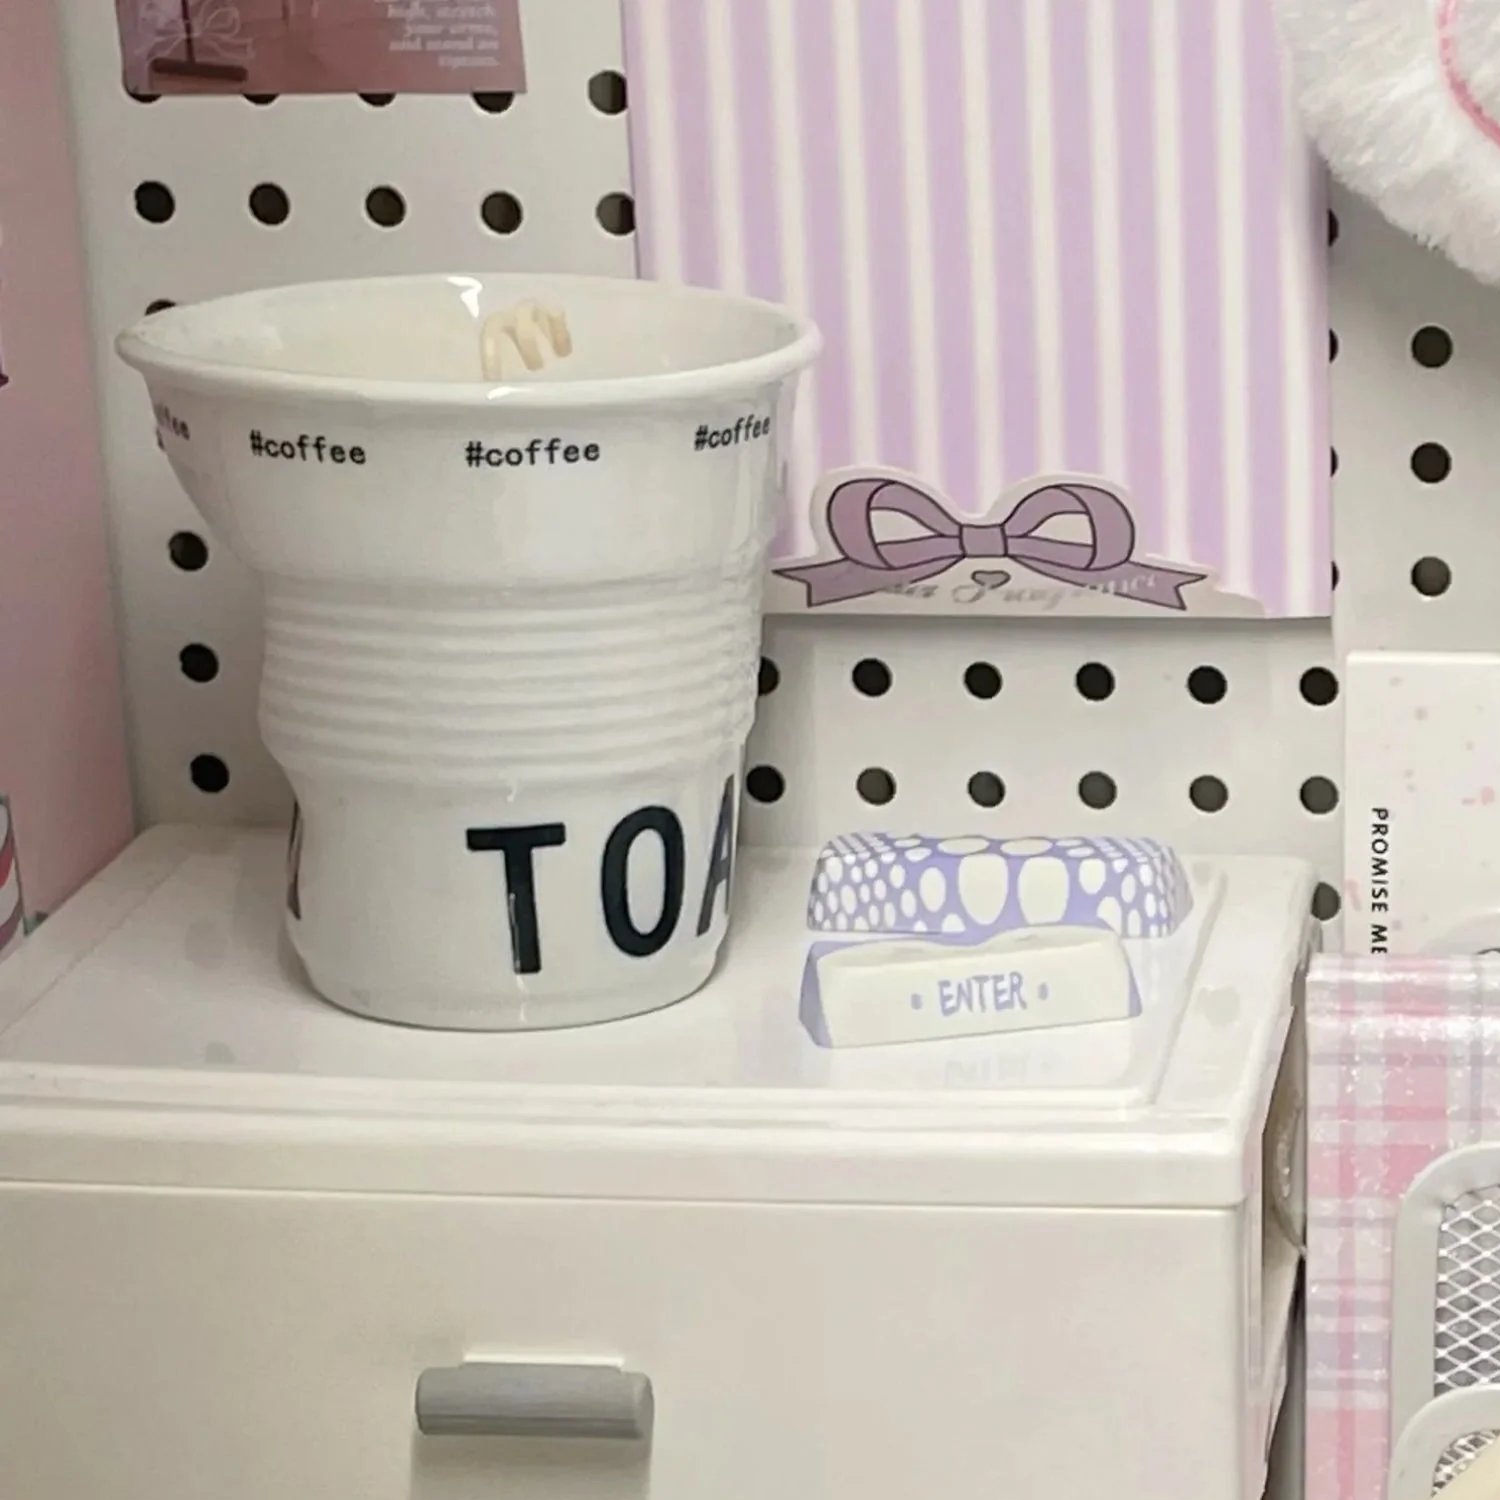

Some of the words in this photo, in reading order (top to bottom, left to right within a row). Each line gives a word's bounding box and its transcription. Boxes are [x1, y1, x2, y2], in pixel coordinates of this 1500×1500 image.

[249, 428, 367, 466] #coffee
[694, 413, 771, 451] #coffee
[464, 437, 601, 468] #coffee
[1370, 806, 1390, 913] PROMISE
[1370, 923, 1389, 955] ME
[937, 970, 1029, 1017] ENTER
